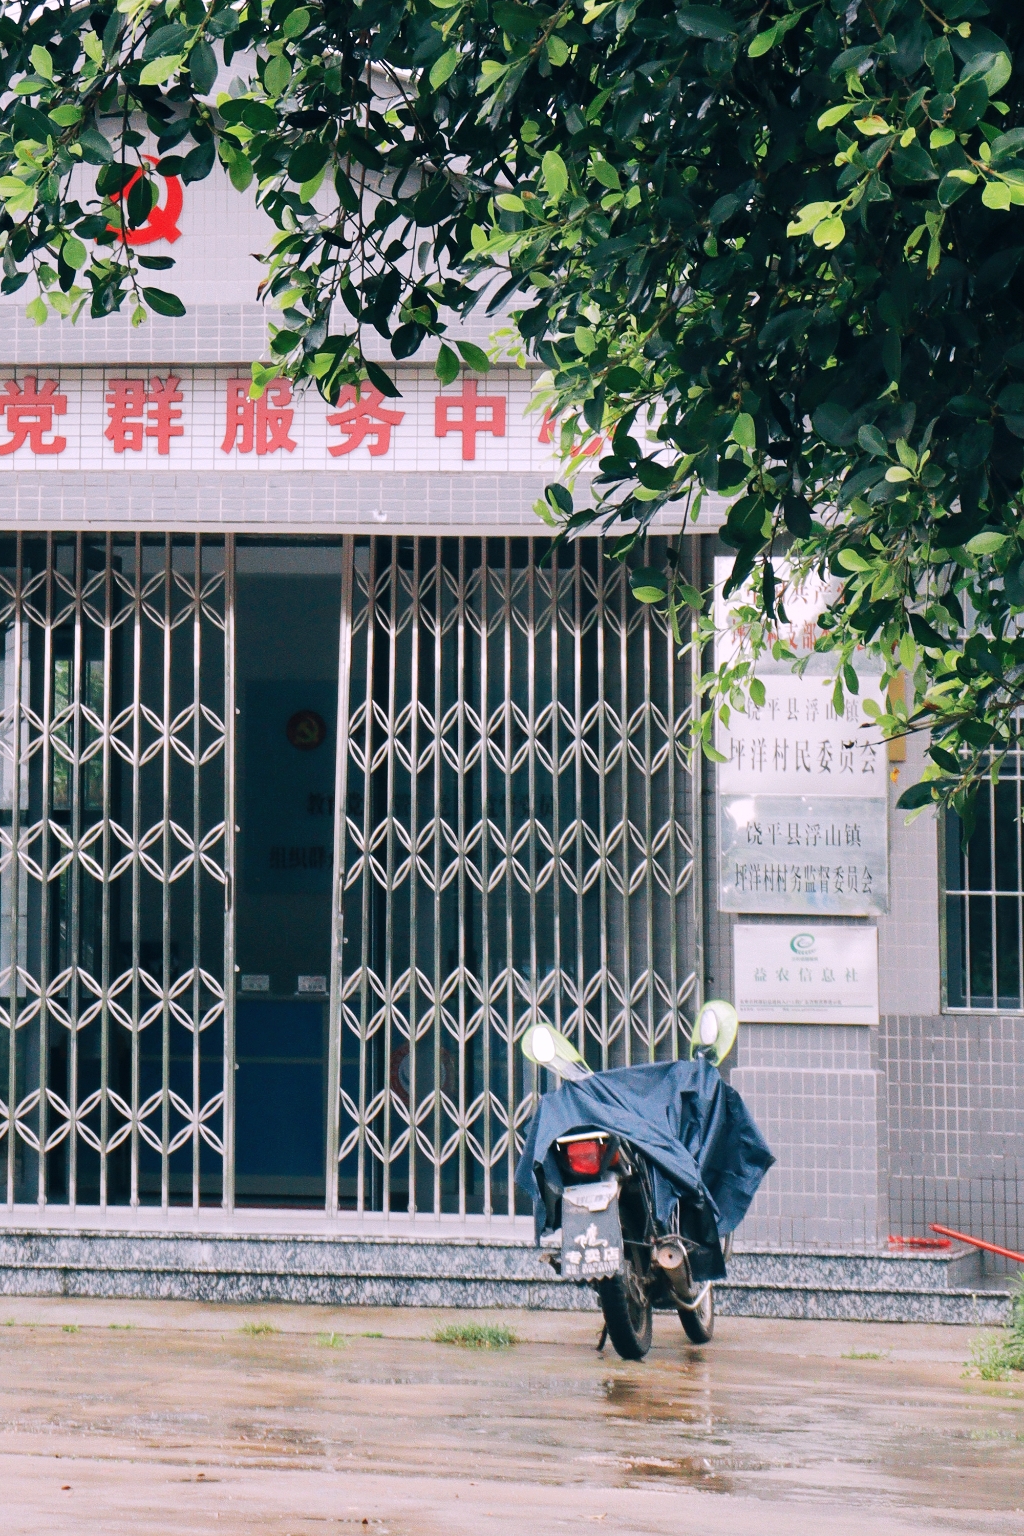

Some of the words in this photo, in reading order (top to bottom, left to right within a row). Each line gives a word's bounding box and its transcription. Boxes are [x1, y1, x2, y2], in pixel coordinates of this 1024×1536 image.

[729, 737, 877, 774] 坪洋村民委员会
[746, 821, 862, 848] 饶平县浮山镇
[735, 863, 872, 894] 坪洋村村务监督委员会
[754, 967, 858, 983] 益农信息社
